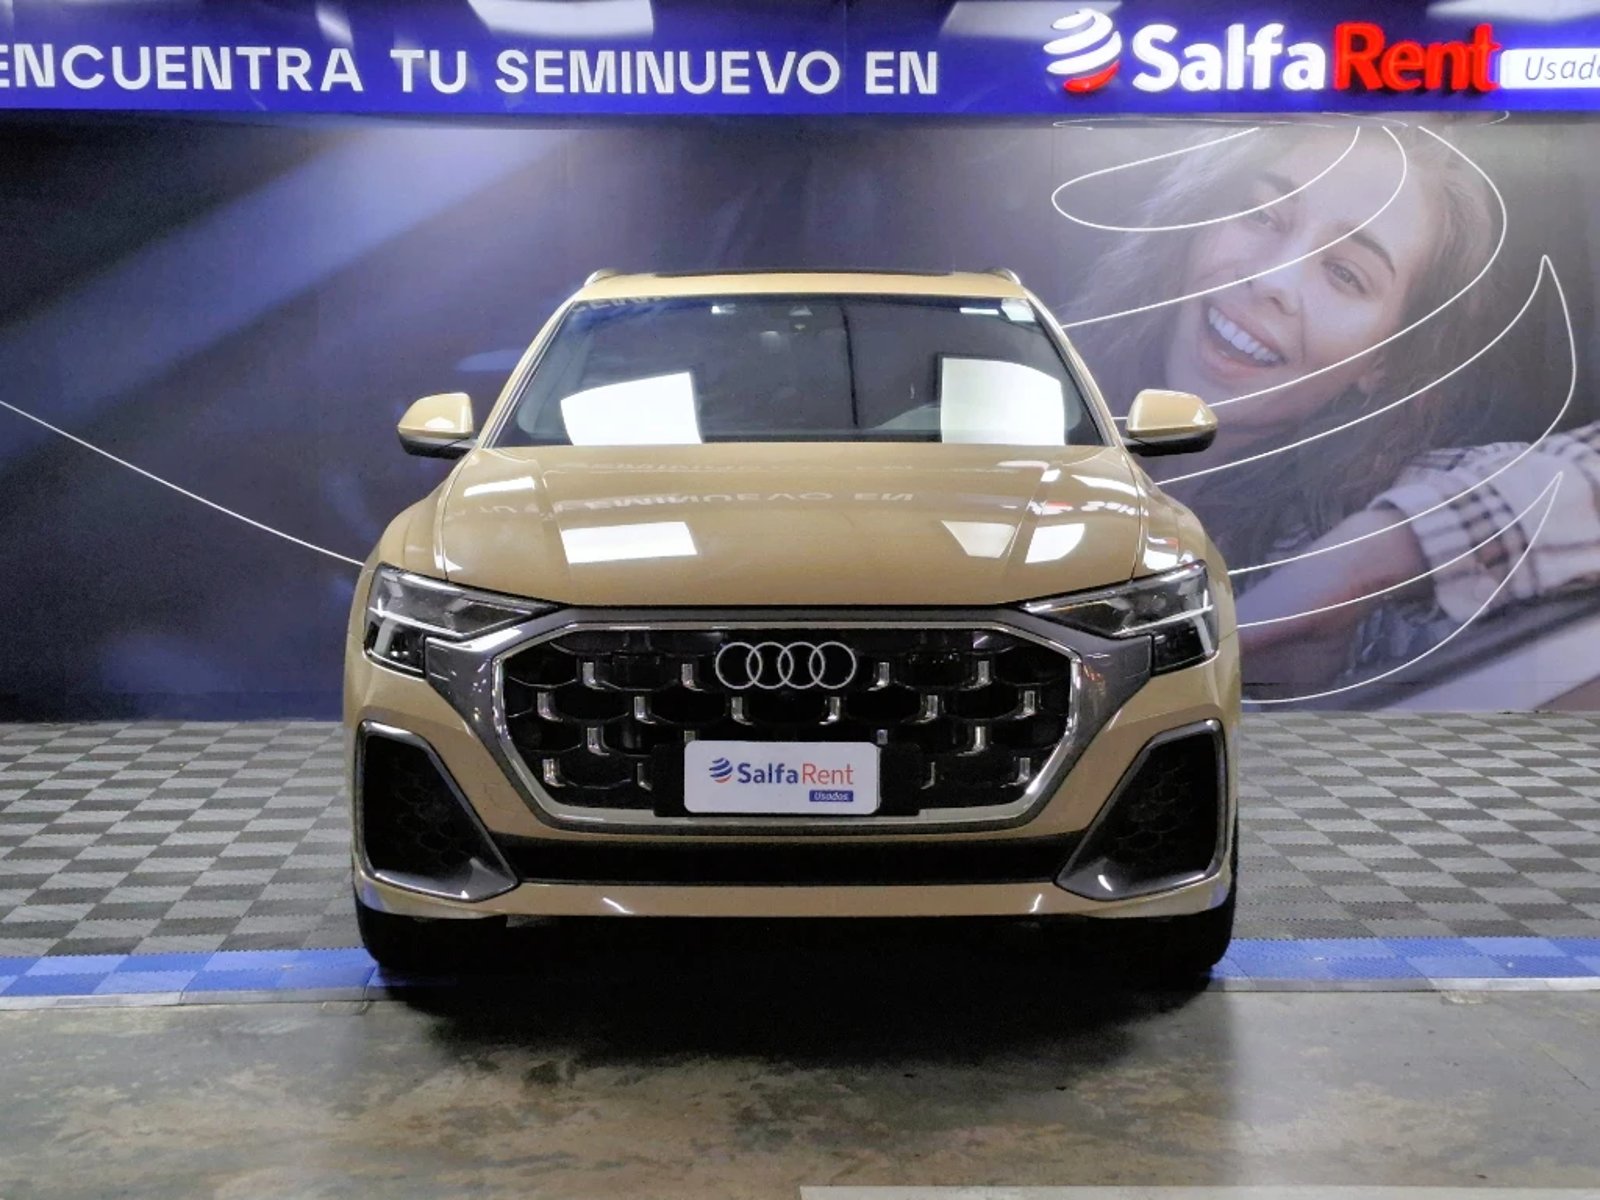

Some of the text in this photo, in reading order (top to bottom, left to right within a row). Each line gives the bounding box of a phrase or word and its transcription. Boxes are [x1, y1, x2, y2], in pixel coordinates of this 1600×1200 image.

[391, 49, 467, 94] TU
[496, 50, 841, 95] SEMINUEVO
[865, 51, 938, 95] EN
[1525, 55, 1600, 81] Usad
